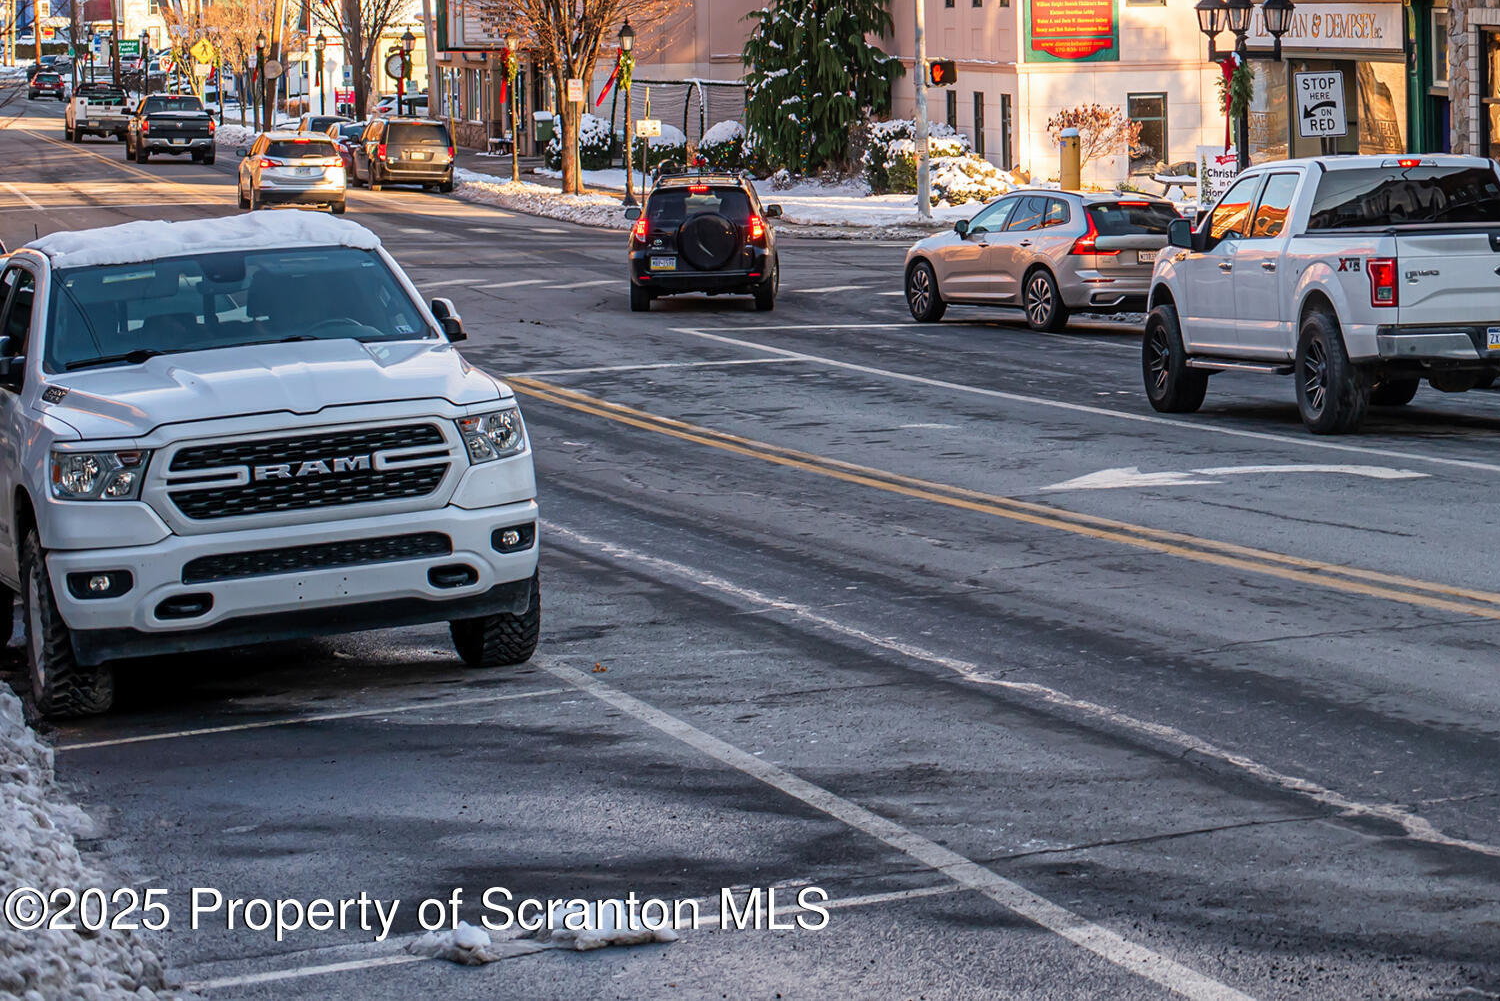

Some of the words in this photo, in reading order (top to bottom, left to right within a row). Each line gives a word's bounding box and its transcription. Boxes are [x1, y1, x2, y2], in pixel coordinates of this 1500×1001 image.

[1311, 14, 1322, 39] &
[1325, 12, 1376, 40] DEMPSEY
[1302, 77, 1336, 90] STOP
[1309, 91, 1331, 101] HERE
[1320, 108, 1332, 117] ON
[1310, 118, 1336, 131] RED
[253, 454, 371, 482] RAM
